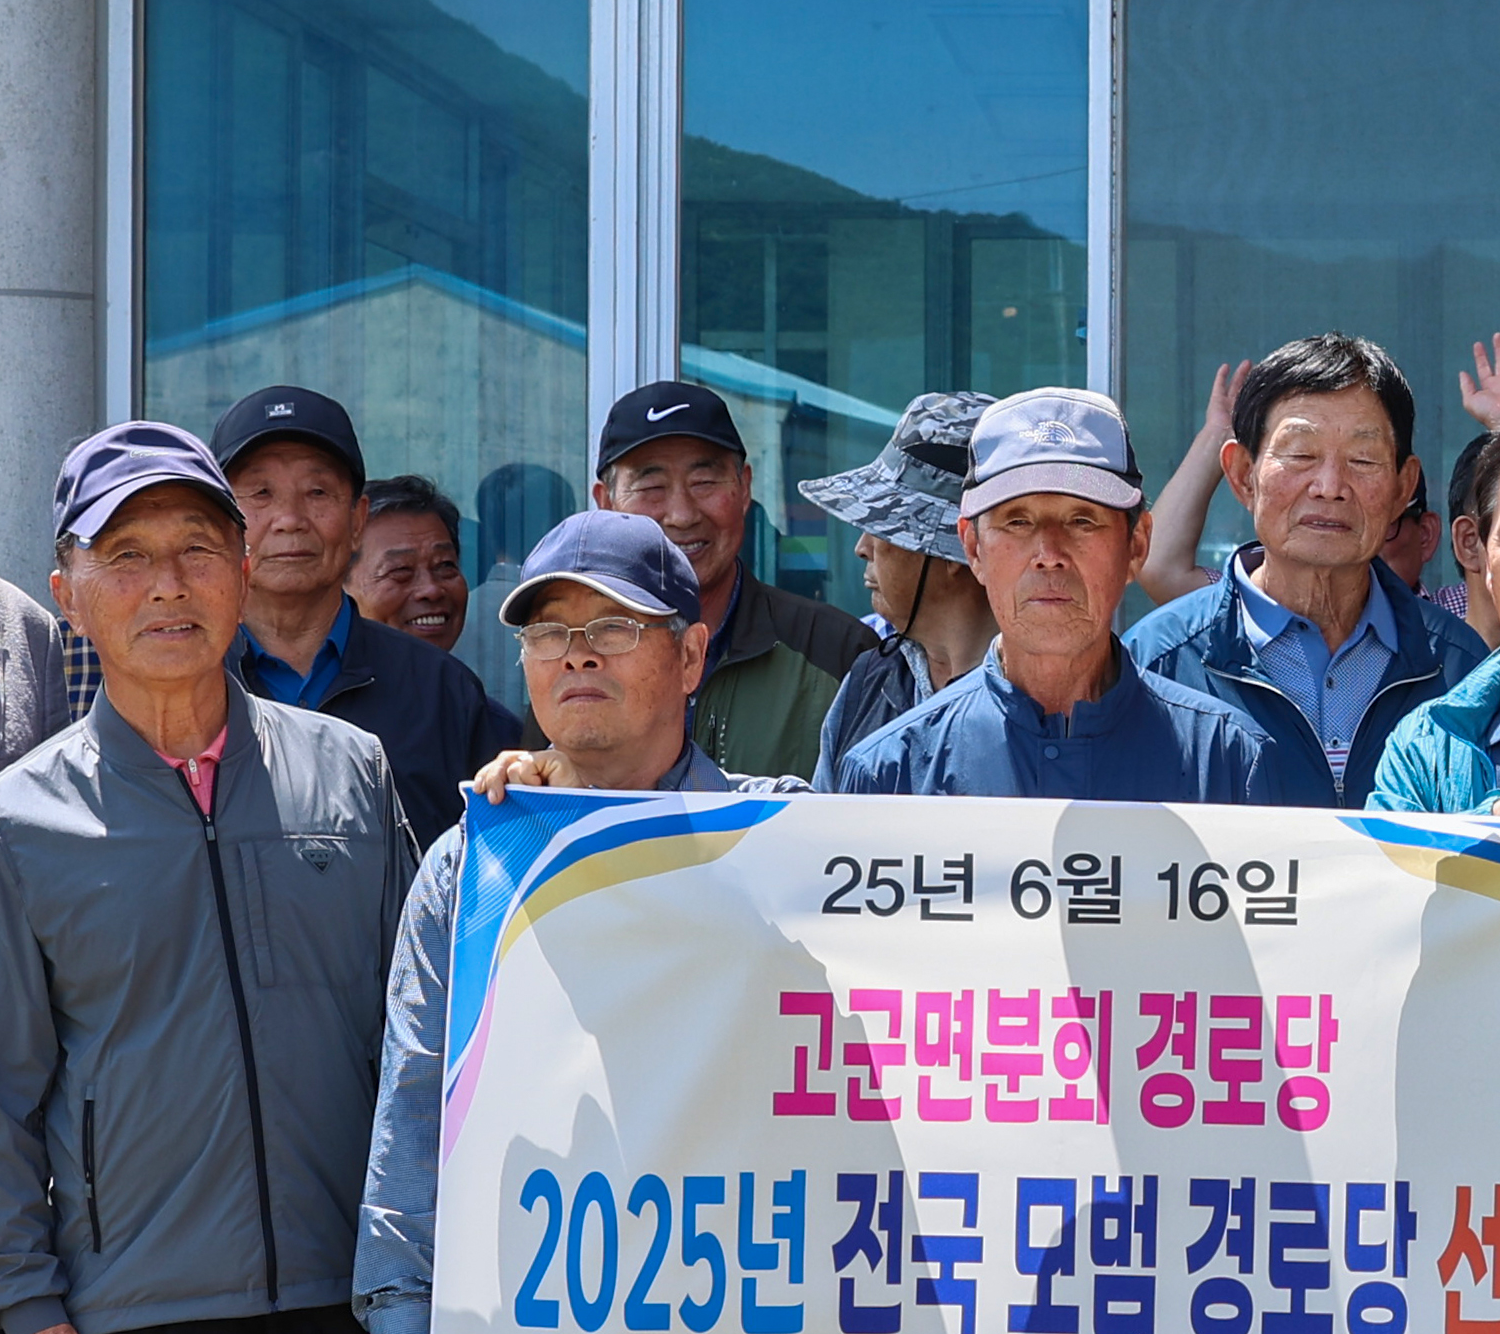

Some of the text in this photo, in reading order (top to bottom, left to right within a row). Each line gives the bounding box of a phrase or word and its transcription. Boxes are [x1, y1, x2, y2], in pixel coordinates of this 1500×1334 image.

[822, 853, 1300, 926] 25년 6월 16일
[772, 986, 1340, 1133] 고군면분회 경로당
[514, 1168, 807, 1334] 2025년
